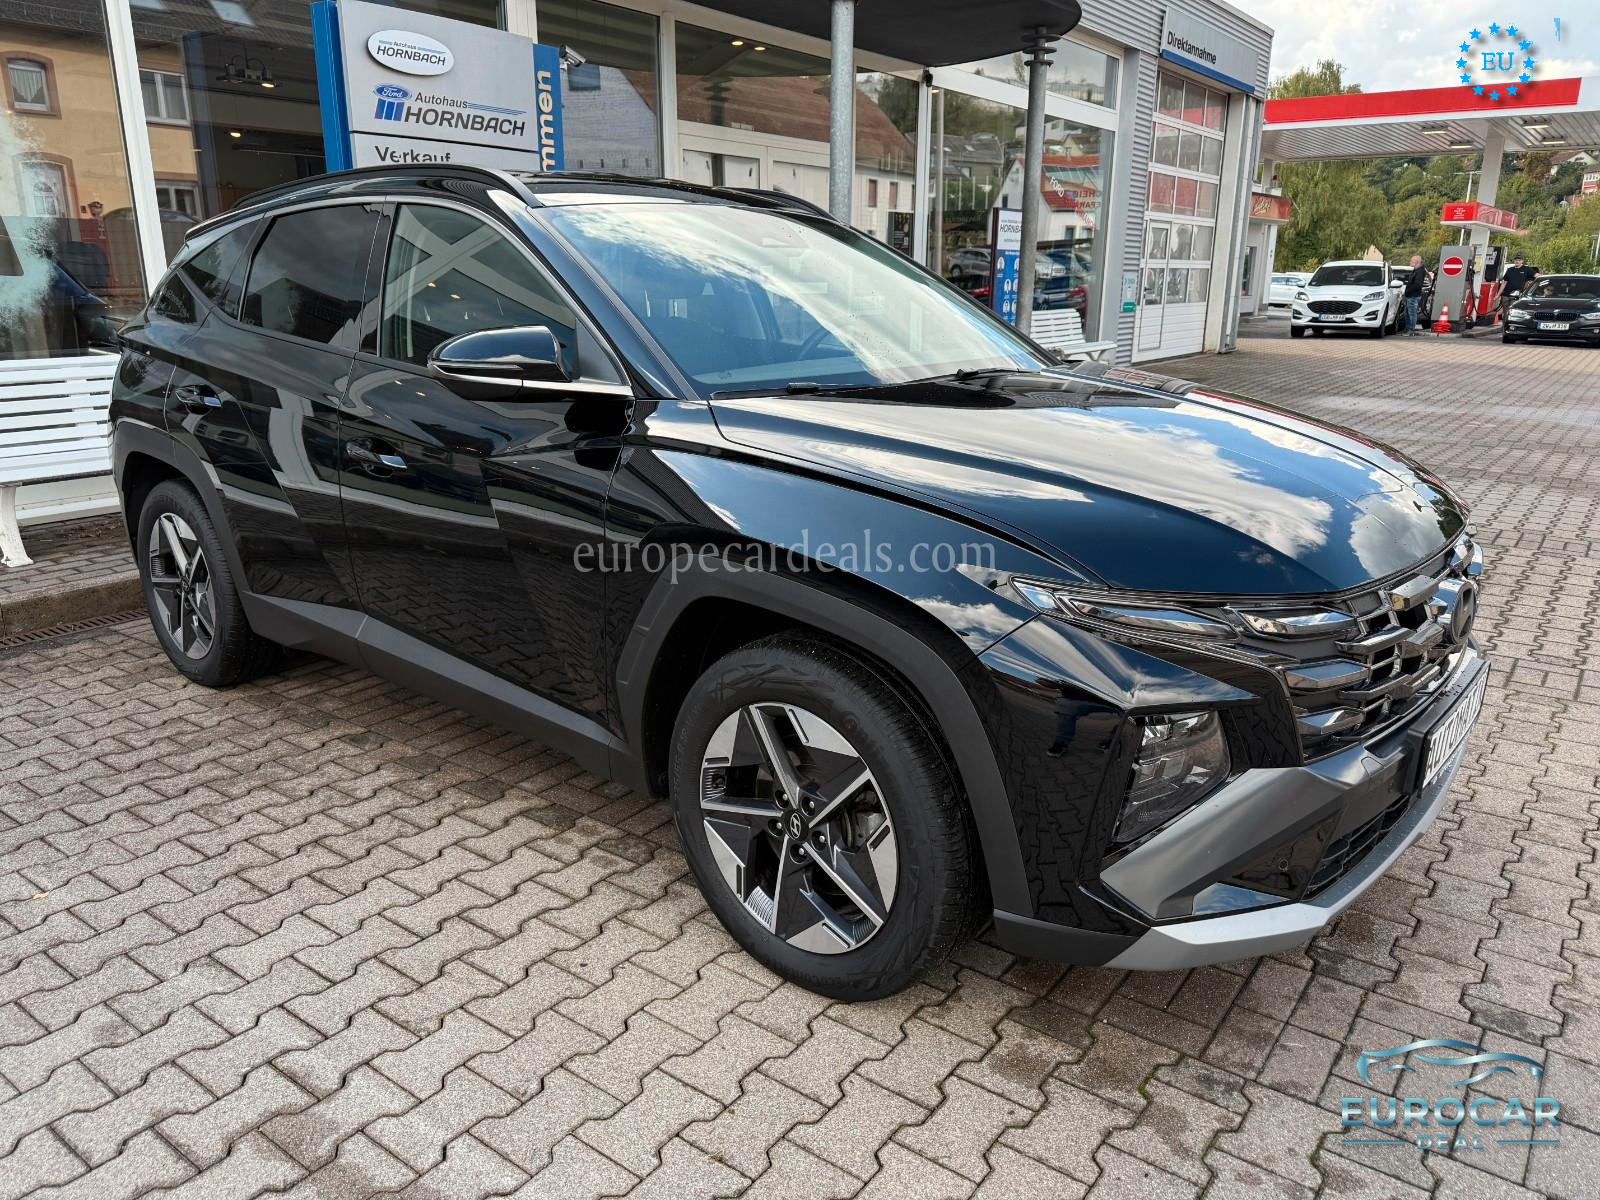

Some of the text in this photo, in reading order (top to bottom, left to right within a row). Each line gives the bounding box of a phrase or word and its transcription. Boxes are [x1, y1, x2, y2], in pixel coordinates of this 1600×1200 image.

[377, 45, 446, 66] HORNBACH
[393, 41, 417, 50] Autohaus
[1167, 30, 1216, 64] Direktannahme
[381, 87, 403, 98] Ford
[414, 92, 468, 109] Autohaus
[404, 106, 525, 136] HORNBACH
[1050, 176, 1065, 198] FORD
